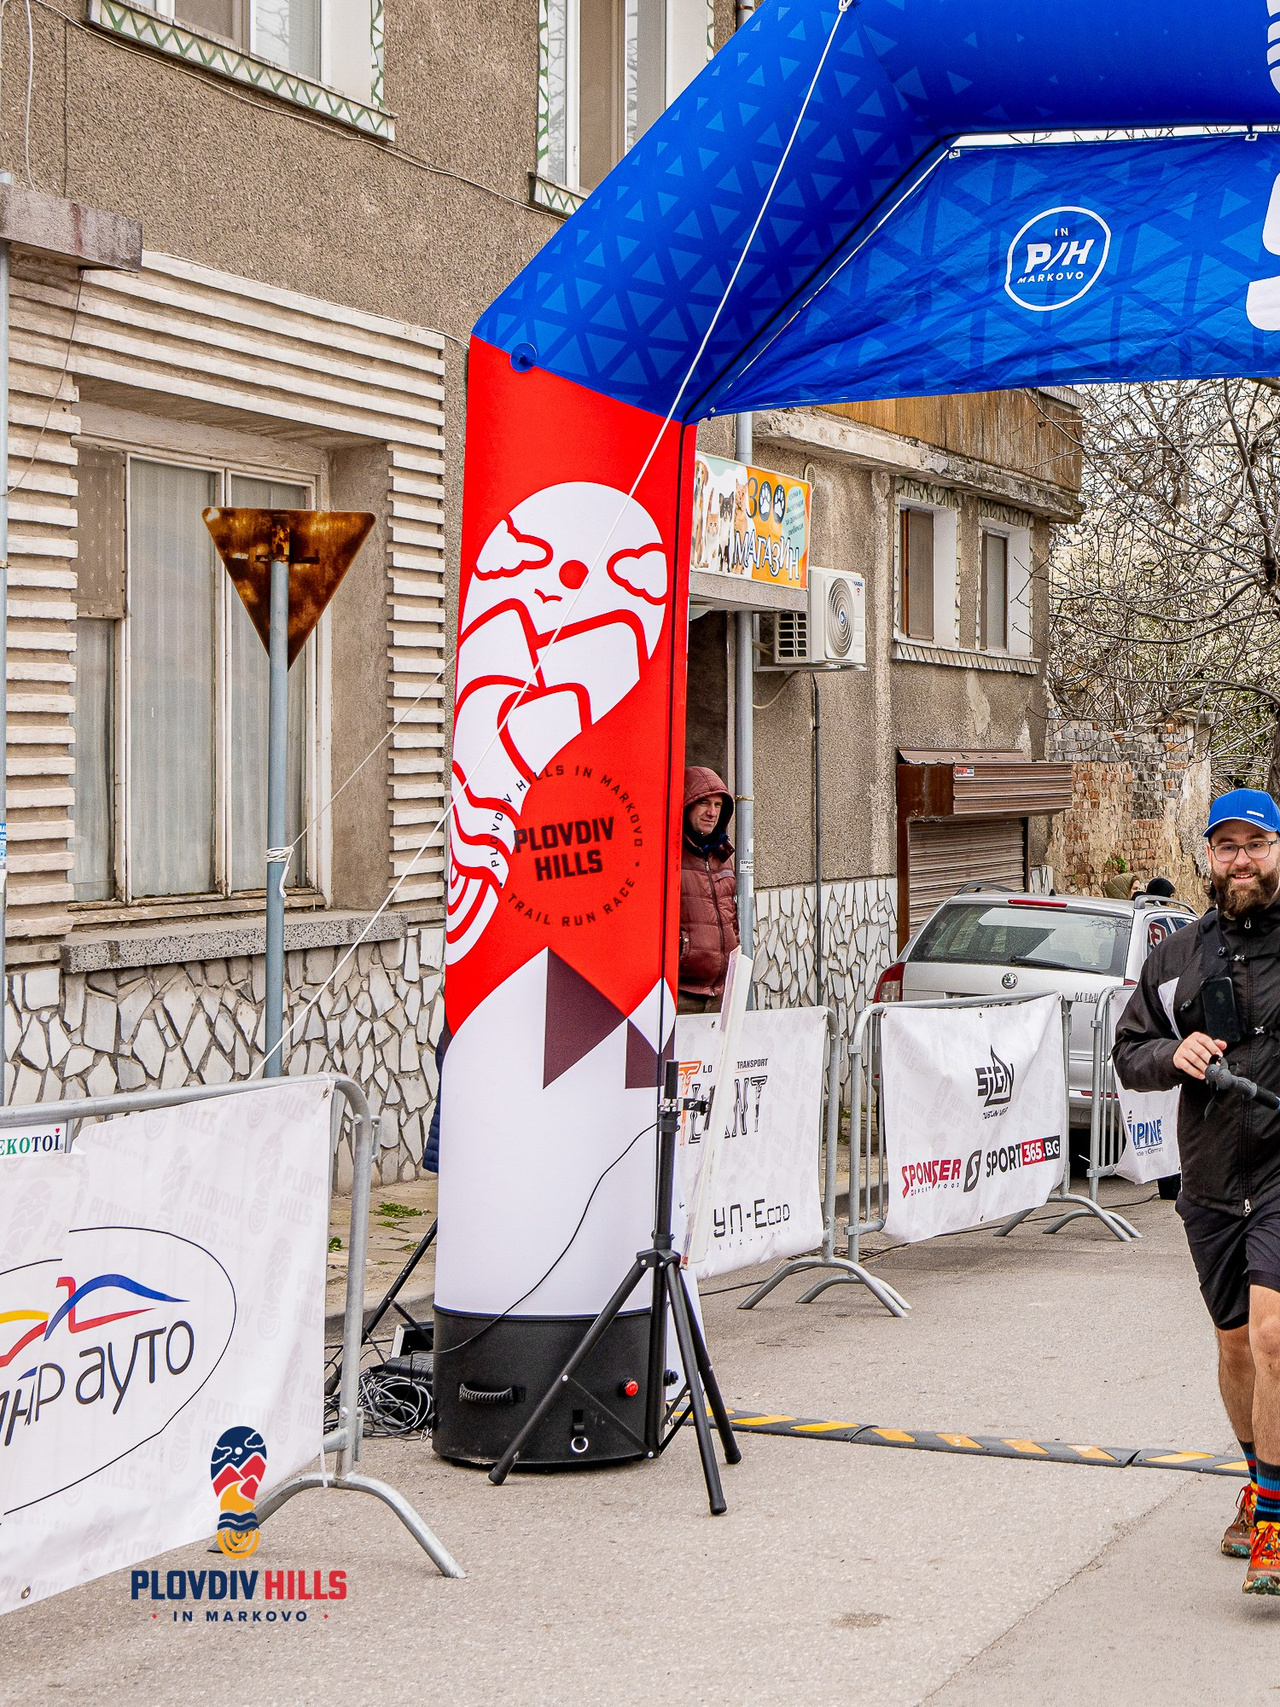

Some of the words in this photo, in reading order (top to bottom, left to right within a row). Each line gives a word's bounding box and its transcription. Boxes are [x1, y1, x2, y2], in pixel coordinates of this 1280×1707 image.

[1054, 227, 1069, 237] IN
[1024, 239, 1095, 274] P/H
[1016, 271, 1085, 284] MARKOVO
[733, 529, 800, 581] МАГАЗИН
[491, 793, 513, 868] PLOVDIV
[516, 764, 565, 792] HILLS
[574, 764, 593, 779] IN
[600, 774, 644, 848] MARKOVO
[513, 816, 615, 854] PLOVDIV
[534, 849, 604, 882] HILLS
[508, 892, 551, 926] TRAIL
[561, 911, 597, 928] RUN
[603, 877, 636, 916] RACE
[736, 1057, 769, 1070] TRANSPORT
[901, 1158, 962, 1199] SPONSER
[986, 1136, 1061, 1178] SPORT365.BG
